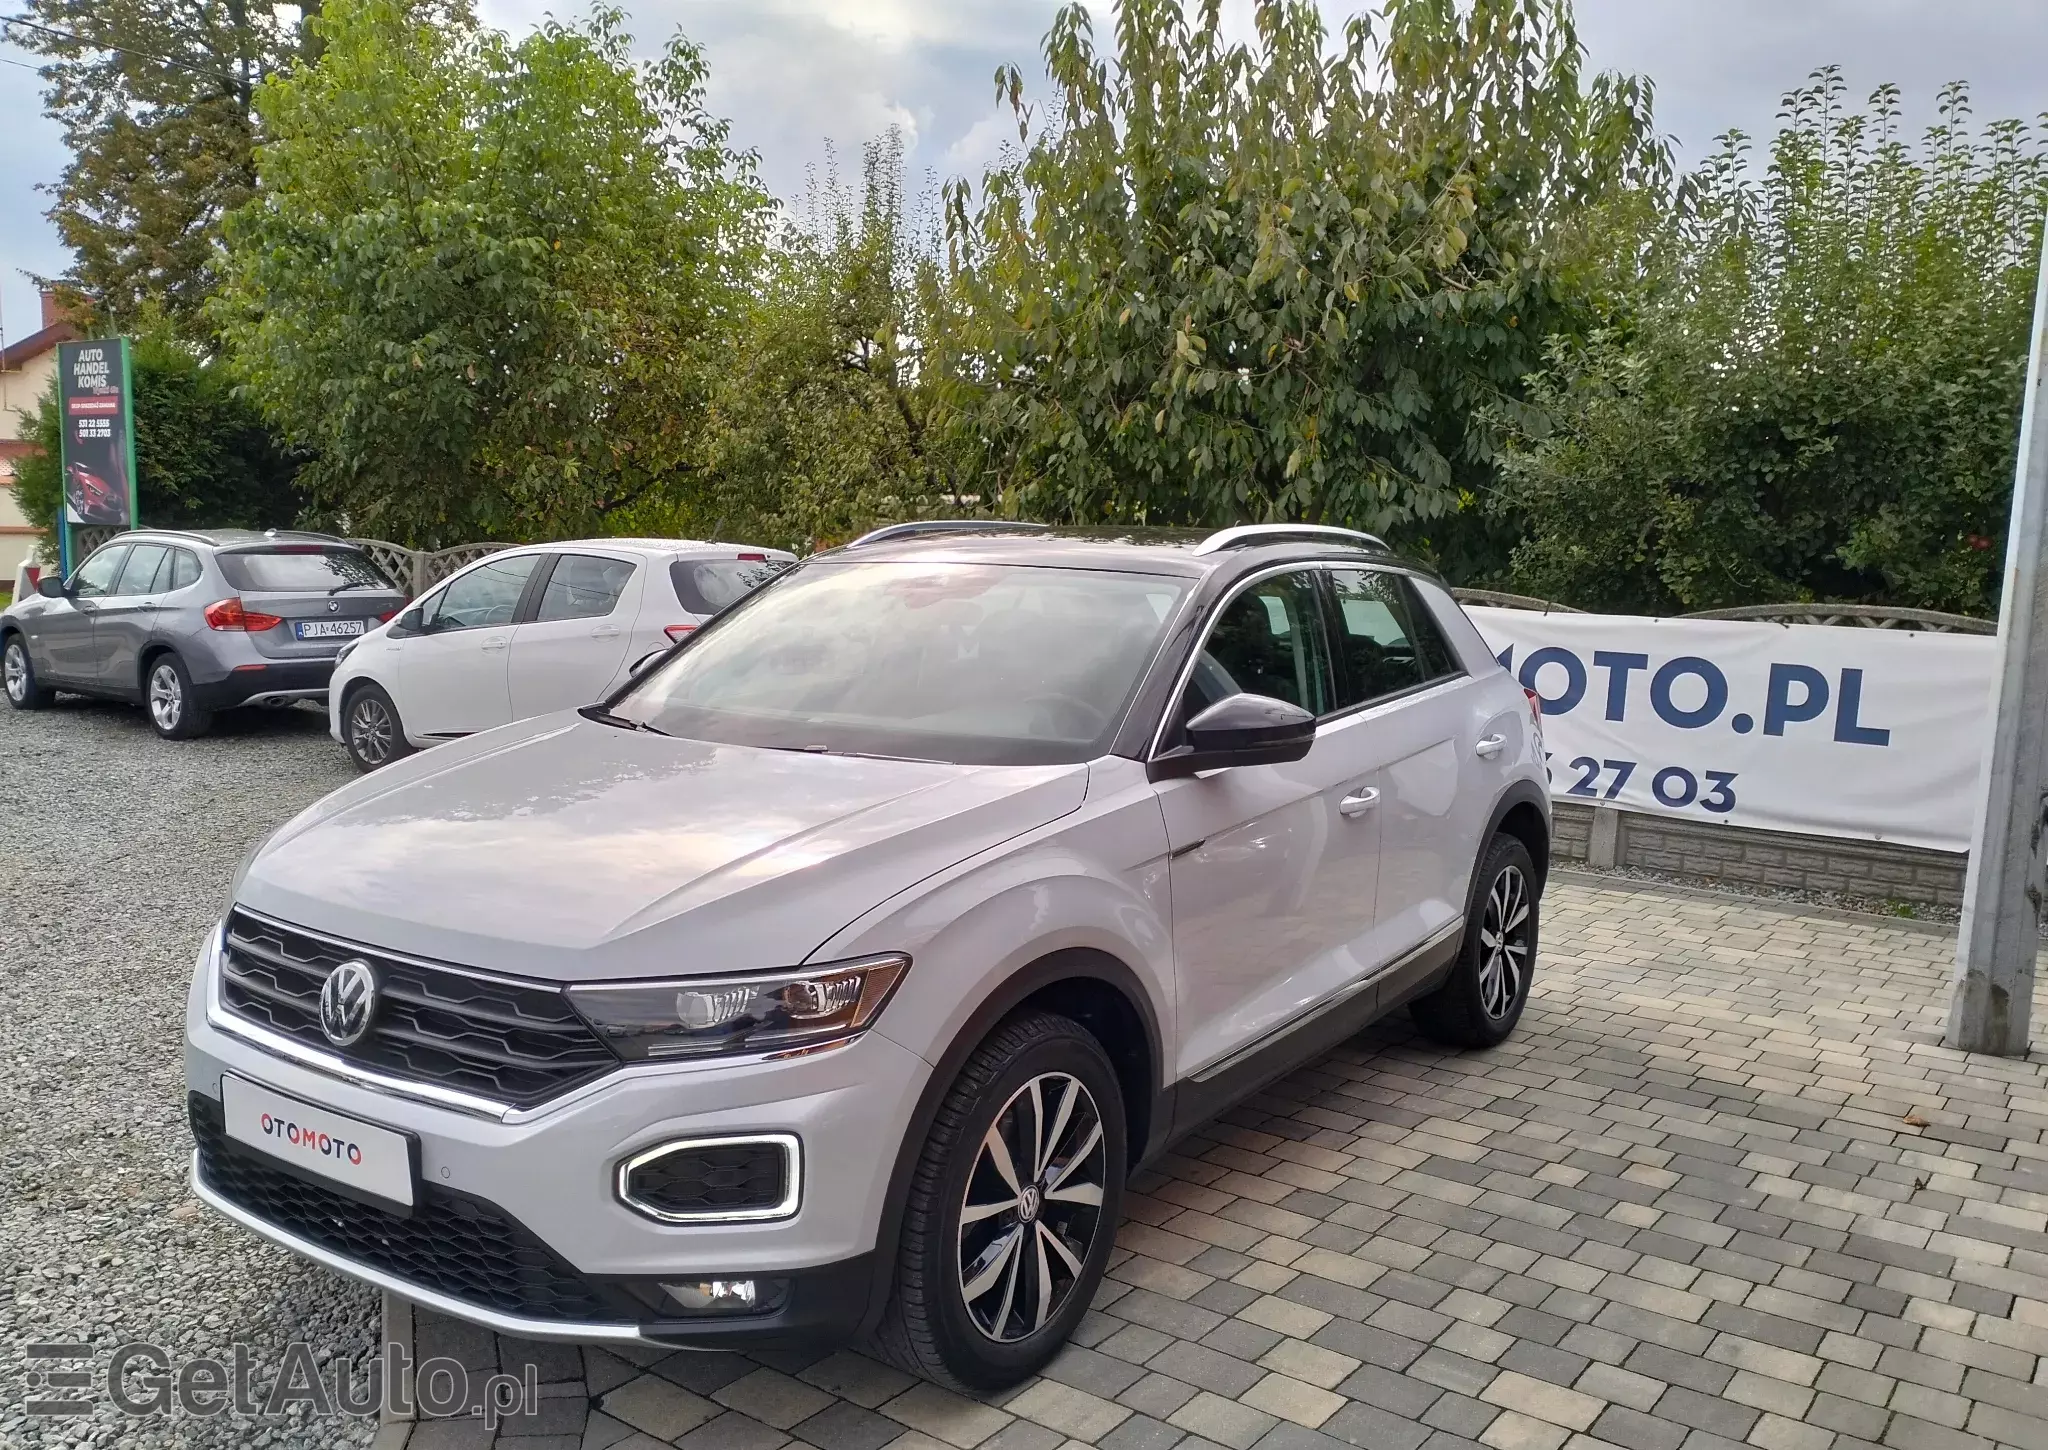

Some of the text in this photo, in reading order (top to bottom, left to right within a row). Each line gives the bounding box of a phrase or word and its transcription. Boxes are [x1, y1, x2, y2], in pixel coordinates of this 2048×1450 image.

[78, 348, 103, 362] AUTO
[73, 362, 110, 375] HANDEL
[77, 375, 107, 388] KOMIS
[97, 428, 111, 438] 2703
[303, 621, 362, 636] PJA 46257
[1498, 643, 1891, 747] OTO.PL
[1565, 756, 1637, 800] 27
[1652, 766, 1739, 813] 03
[261, 1113, 362, 1165] OTOMOTO
